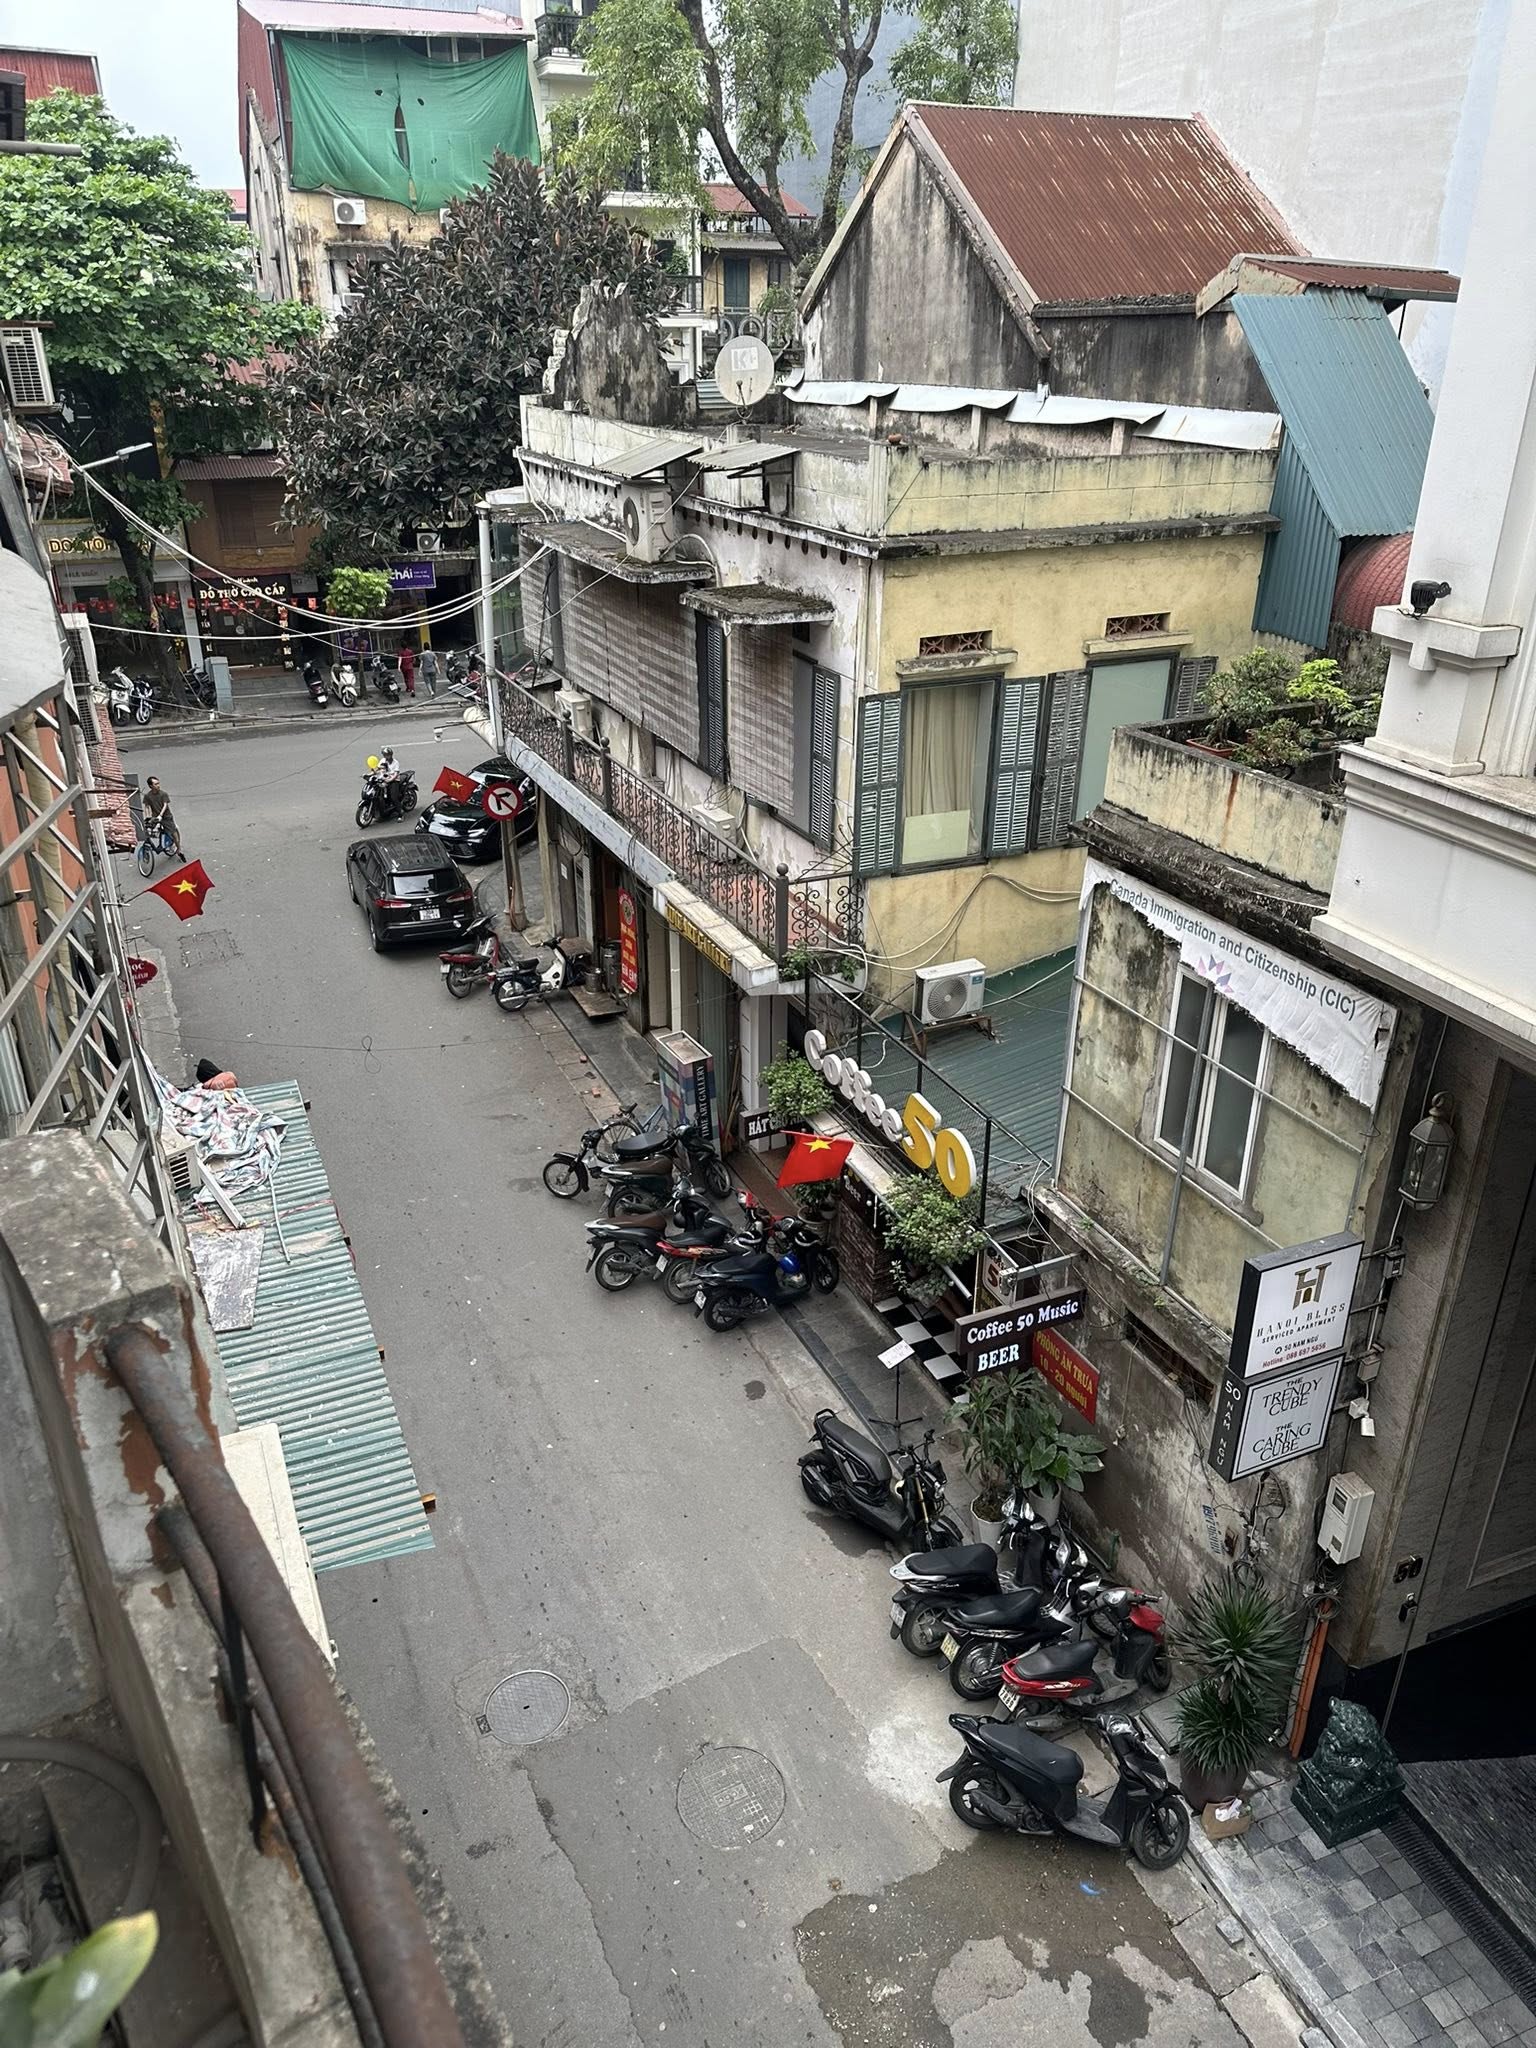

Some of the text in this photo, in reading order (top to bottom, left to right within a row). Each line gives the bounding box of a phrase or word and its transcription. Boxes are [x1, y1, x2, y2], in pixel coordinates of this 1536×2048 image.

[1110, 878, 1356, 1021] Canada Immigration and Citizenship (CIC)
[696, 1065, 707, 1101] GALLERY
[699, 1102, 708, 1118] ART
[748, 1116, 768, 1136] HÁT
[967, 1299, 1079, 1344] Coffee 50 Music
[1256, 1302, 1346, 1338] HANOI BLISS
[1262, 1316, 1336, 1344] SERVICED APARTMENT
[977, 1344, 1020, 1372] BEER
[1284, 1342, 1292, 1352] 50
[1293, 1338, 1306, 1349] NAM
[1039, 1355, 1049, 1370] 10
[1054, 1369, 1065, 1386] 20
[1286, 1377, 1303, 1387] THE
[1224, 1380, 1241, 1401] 50
[1262, 1377, 1323, 1408] TRENDY
[1269, 1392, 1310, 1416] CUBE
[1223, 1401, 1234, 1430] NAM
[1276, 1421, 1294, 1433] THE
[1252, 1422, 1312, 1453] CARING
[1260, 1437, 1300, 1461] CUBE
